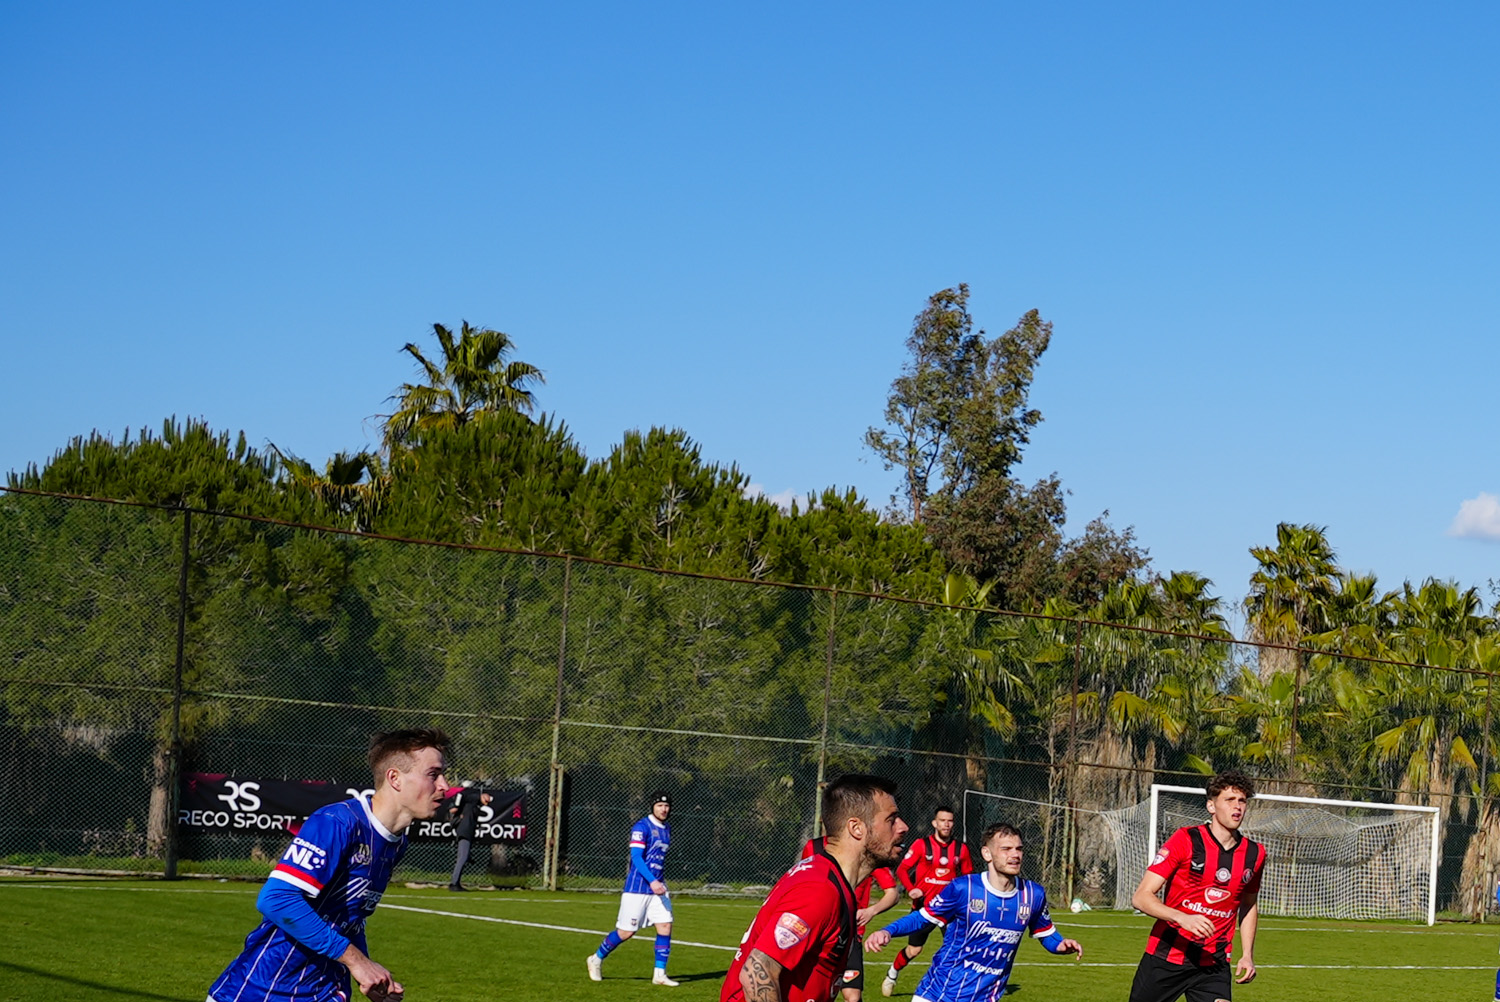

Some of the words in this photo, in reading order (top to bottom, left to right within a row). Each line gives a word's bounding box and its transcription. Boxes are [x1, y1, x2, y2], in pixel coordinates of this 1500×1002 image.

[218, 780, 261, 812] RS
[178, 810, 230, 827] RECO
[233, 813, 296, 830] SPORT
[419, 822, 457, 837] REC
